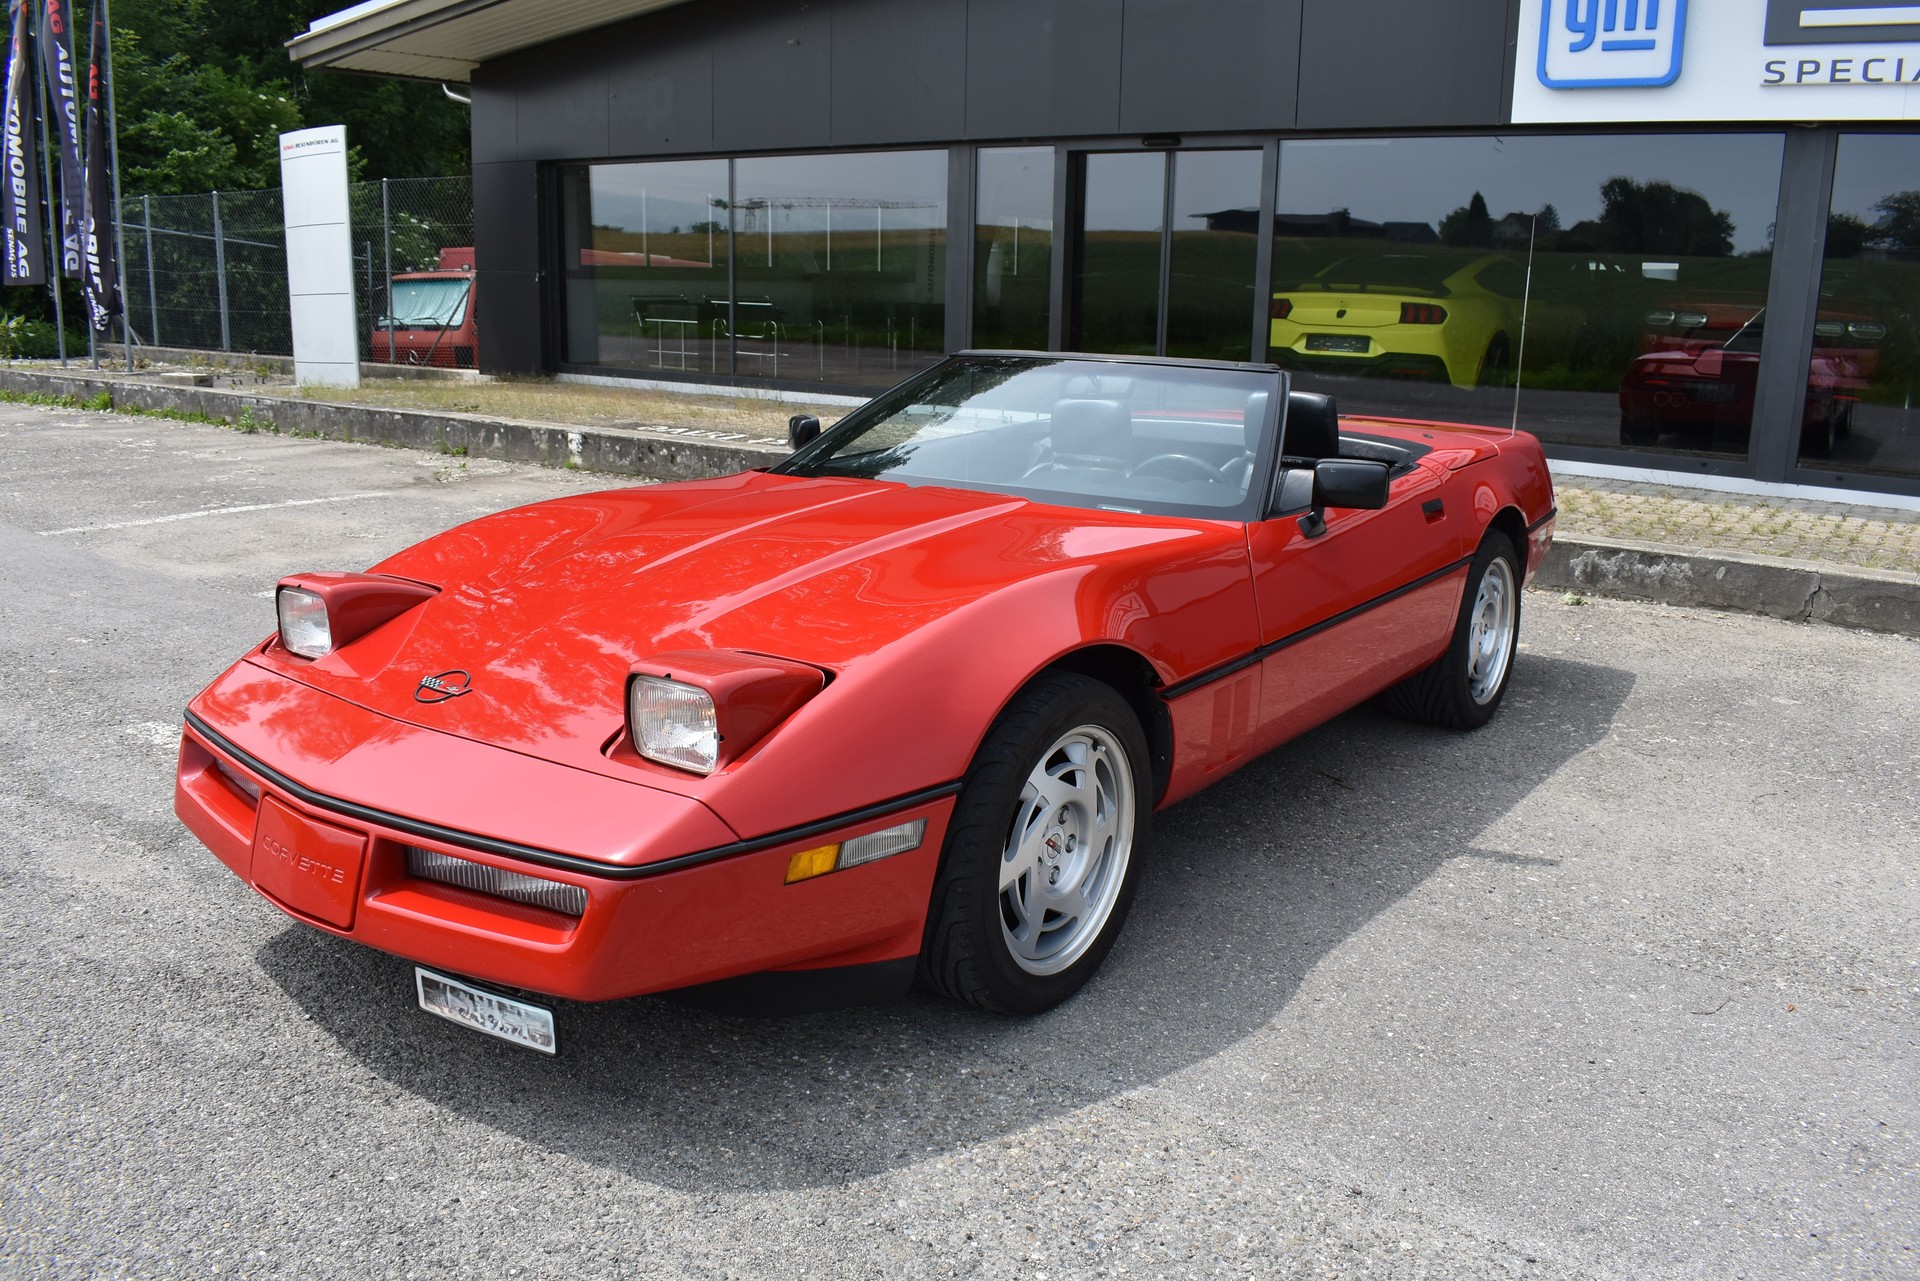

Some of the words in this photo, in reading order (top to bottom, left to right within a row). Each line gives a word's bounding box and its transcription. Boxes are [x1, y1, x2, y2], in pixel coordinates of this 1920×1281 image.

[8, 95, 27, 233] TOMOBILE
[17, 240, 30, 277] AG
[262, 835, 345, 884] CORVETTE
